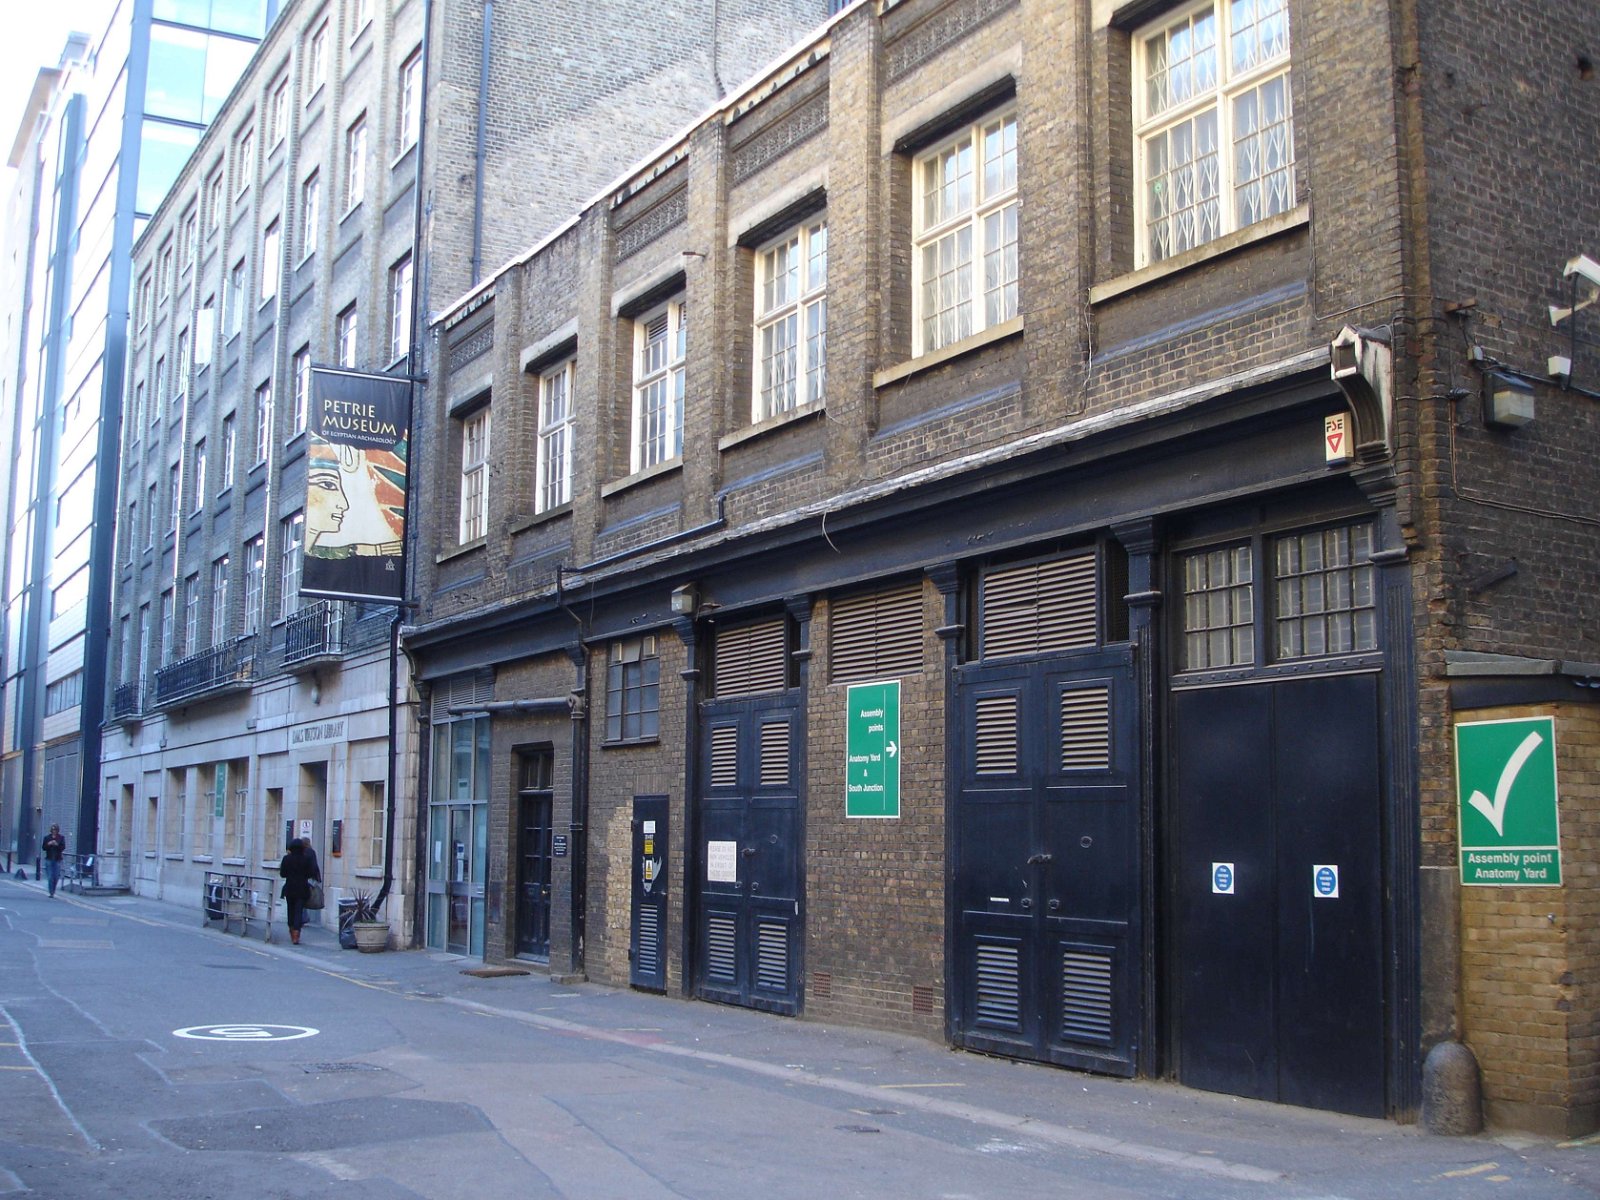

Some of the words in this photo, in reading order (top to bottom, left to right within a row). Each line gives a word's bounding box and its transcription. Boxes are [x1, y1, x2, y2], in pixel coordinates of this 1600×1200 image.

[324, 399, 376, 418] PETRIE
[322, 414, 397, 436] MUSEUM
[1326, 419, 1343, 432] FSE
[330, 431, 357, 439] EGYPTIAN
[860, 708, 884, 719] Assembly
[868, 724, 884, 734] points
[848, 754, 869, 764] Anatomy
[869, 752, 881, 762] Yard
[848, 783, 863, 793] South
[862, 783, 884, 792] Junction
[1468, 853, 1520, 866] Assembly
[1522, 853, 1552, 866] point
[1475, 868, 1520, 881] Anatomy
[1522, 868, 1547, 879] Yard
